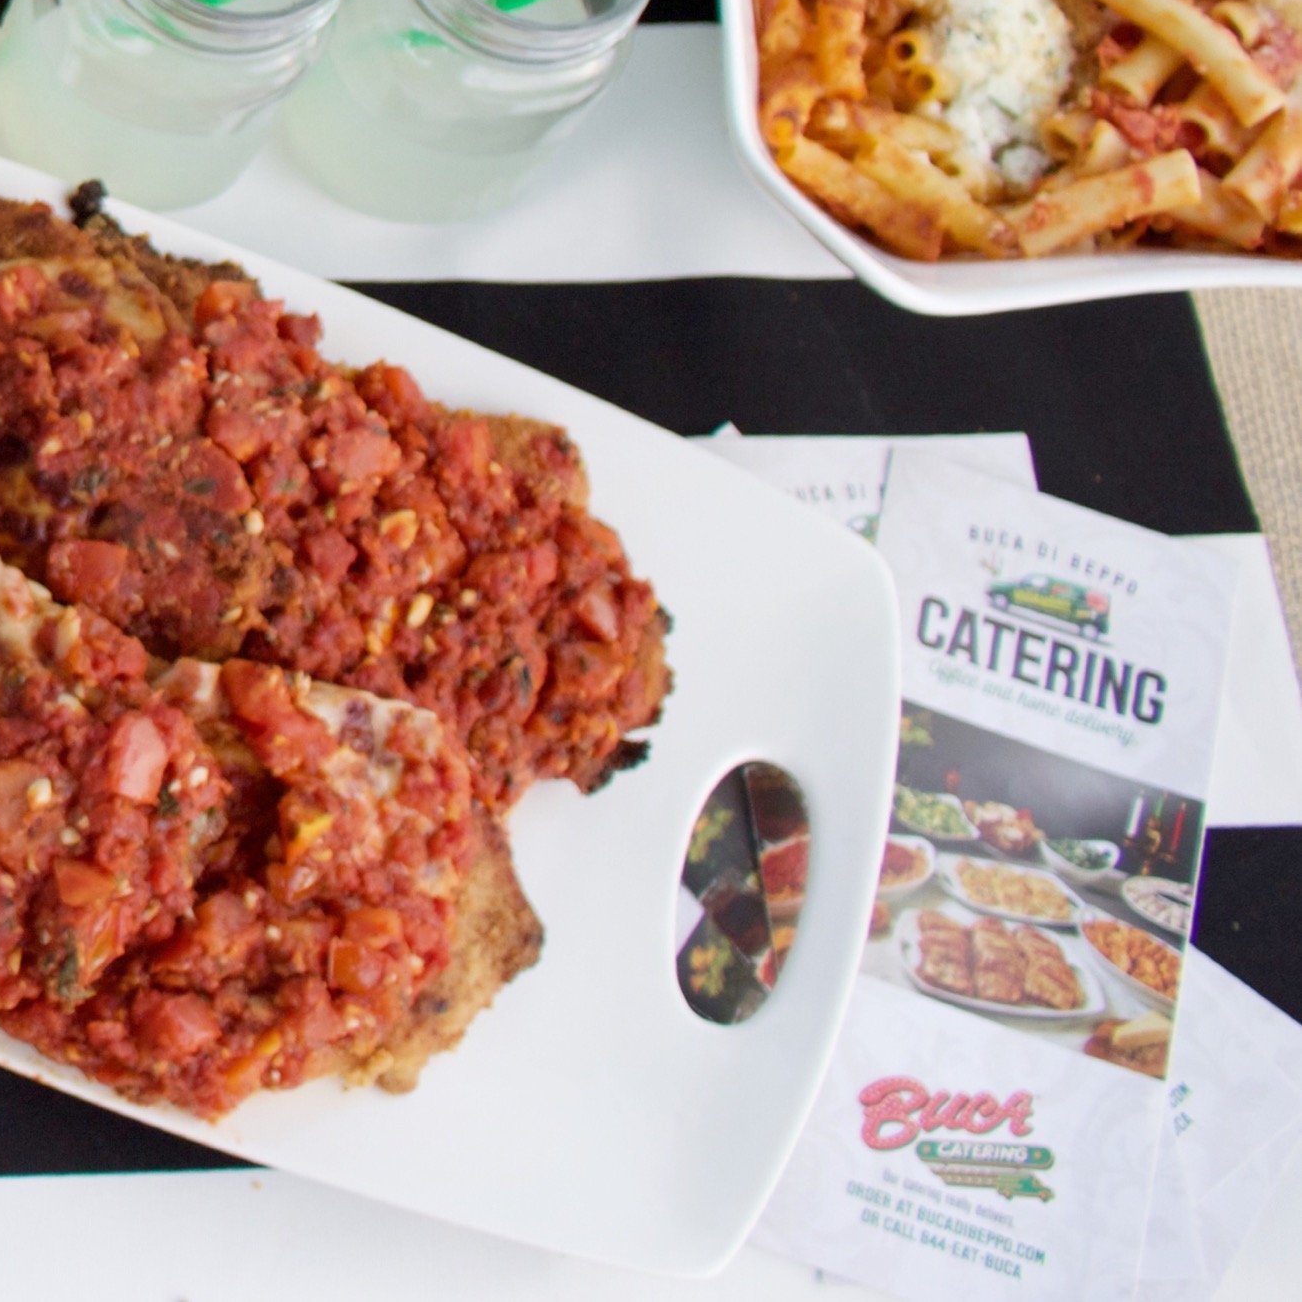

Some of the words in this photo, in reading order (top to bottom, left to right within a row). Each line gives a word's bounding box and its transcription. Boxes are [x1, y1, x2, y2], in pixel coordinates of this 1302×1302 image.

[968, 524, 1023, 549] BUCA
[1037, 541, 1059, 562] DI
[1070, 554, 1139, 595] BEPPO
[916, 594, 1168, 725] CATERING
[937, 1141, 1029, 1164] CATERING
[846, 1179, 892, 1209] ORDER
[895, 1198, 914, 1217] AT
[917, 1205, 1047, 1265] BUCADIBEPPO.COM
[860, 1207, 880, 1228] OR
[883, 1214, 916, 1242] CALL
